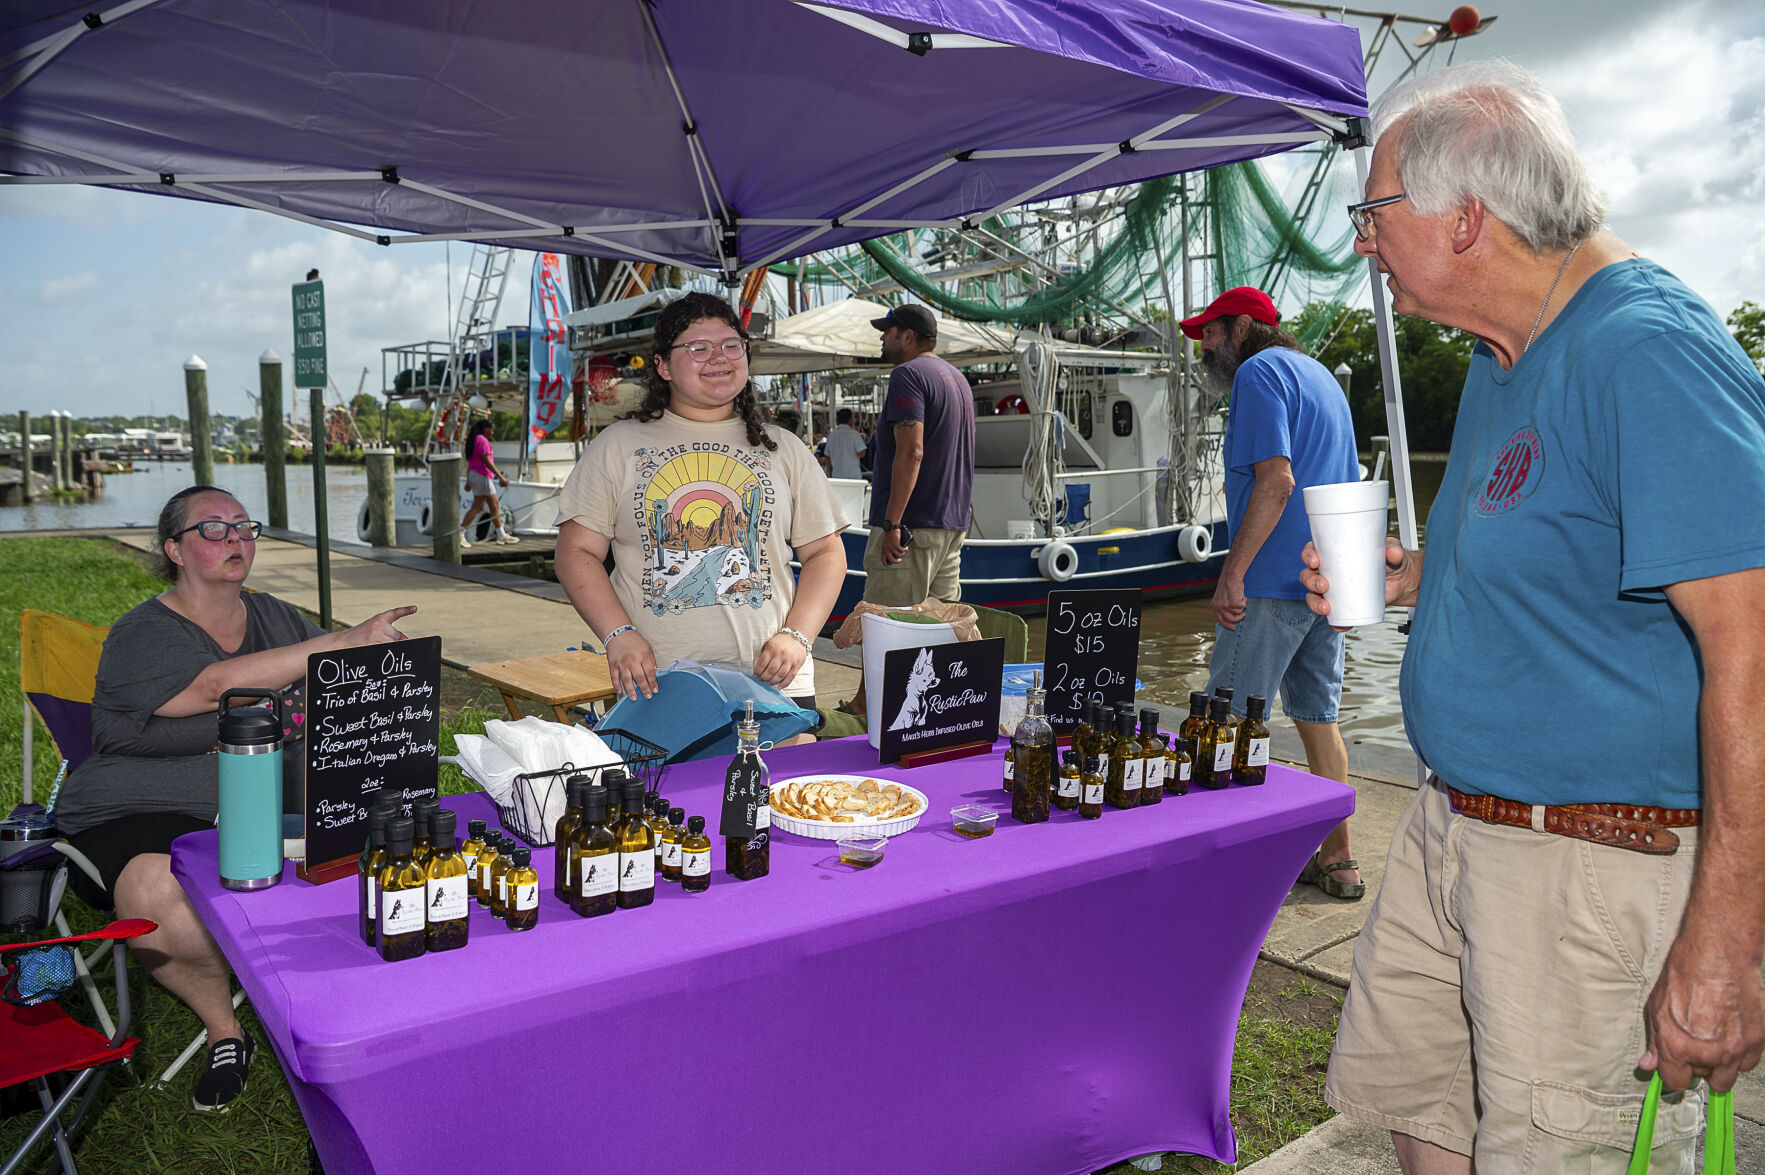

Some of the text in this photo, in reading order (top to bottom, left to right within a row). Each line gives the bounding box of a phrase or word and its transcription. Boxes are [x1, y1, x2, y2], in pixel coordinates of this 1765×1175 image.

[296, 291, 320, 310] NO CAST
[298, 312, 322, 328] NETTING
[297, 332, 324, 348] ALLOWED
[311, 358, 324, 374] FINE
[658, 442, 688, 461] THE
[692, 442, 730, 453] GOOD
[734, 448, 760, 470] THE
[642, 460, 660, 479] ON
[1487, 442, 1532, 502] SKB
[757, 471, 776, 506] GOOD
[634, 483, 647, 529] FOCUS
[641, 534, 653, 565] YOU
[642, 567, 652, 609] WHEN
[1054, 602, 1138, 634] 5 oz Oils
[1074, 634, 1105, 654] $15
[318, 650, 413, 685] Olive Oils
[948, 660, 968, 679] The
[1052, 662, 1126, 692] 2 oz Oils
[322, 680, 433, 709] Trio of Basil & Parsley
[322, 704, 433, 737] Sweet Basil & Parsley
[318, 738, 437, 770] Italian Oregano & Parsley
[320, 728, 412, 754] Rosemary & Parsley
[728, 770, 741, 802] Parsley
[740, 788, 746, 796] &
[746, 770, 759, 826] Sweet Basil
[318, 800, 356, 816] Parsley
[402, 788, 436, 800] Rosemary
[324, 814, 357, 829] Sweet
